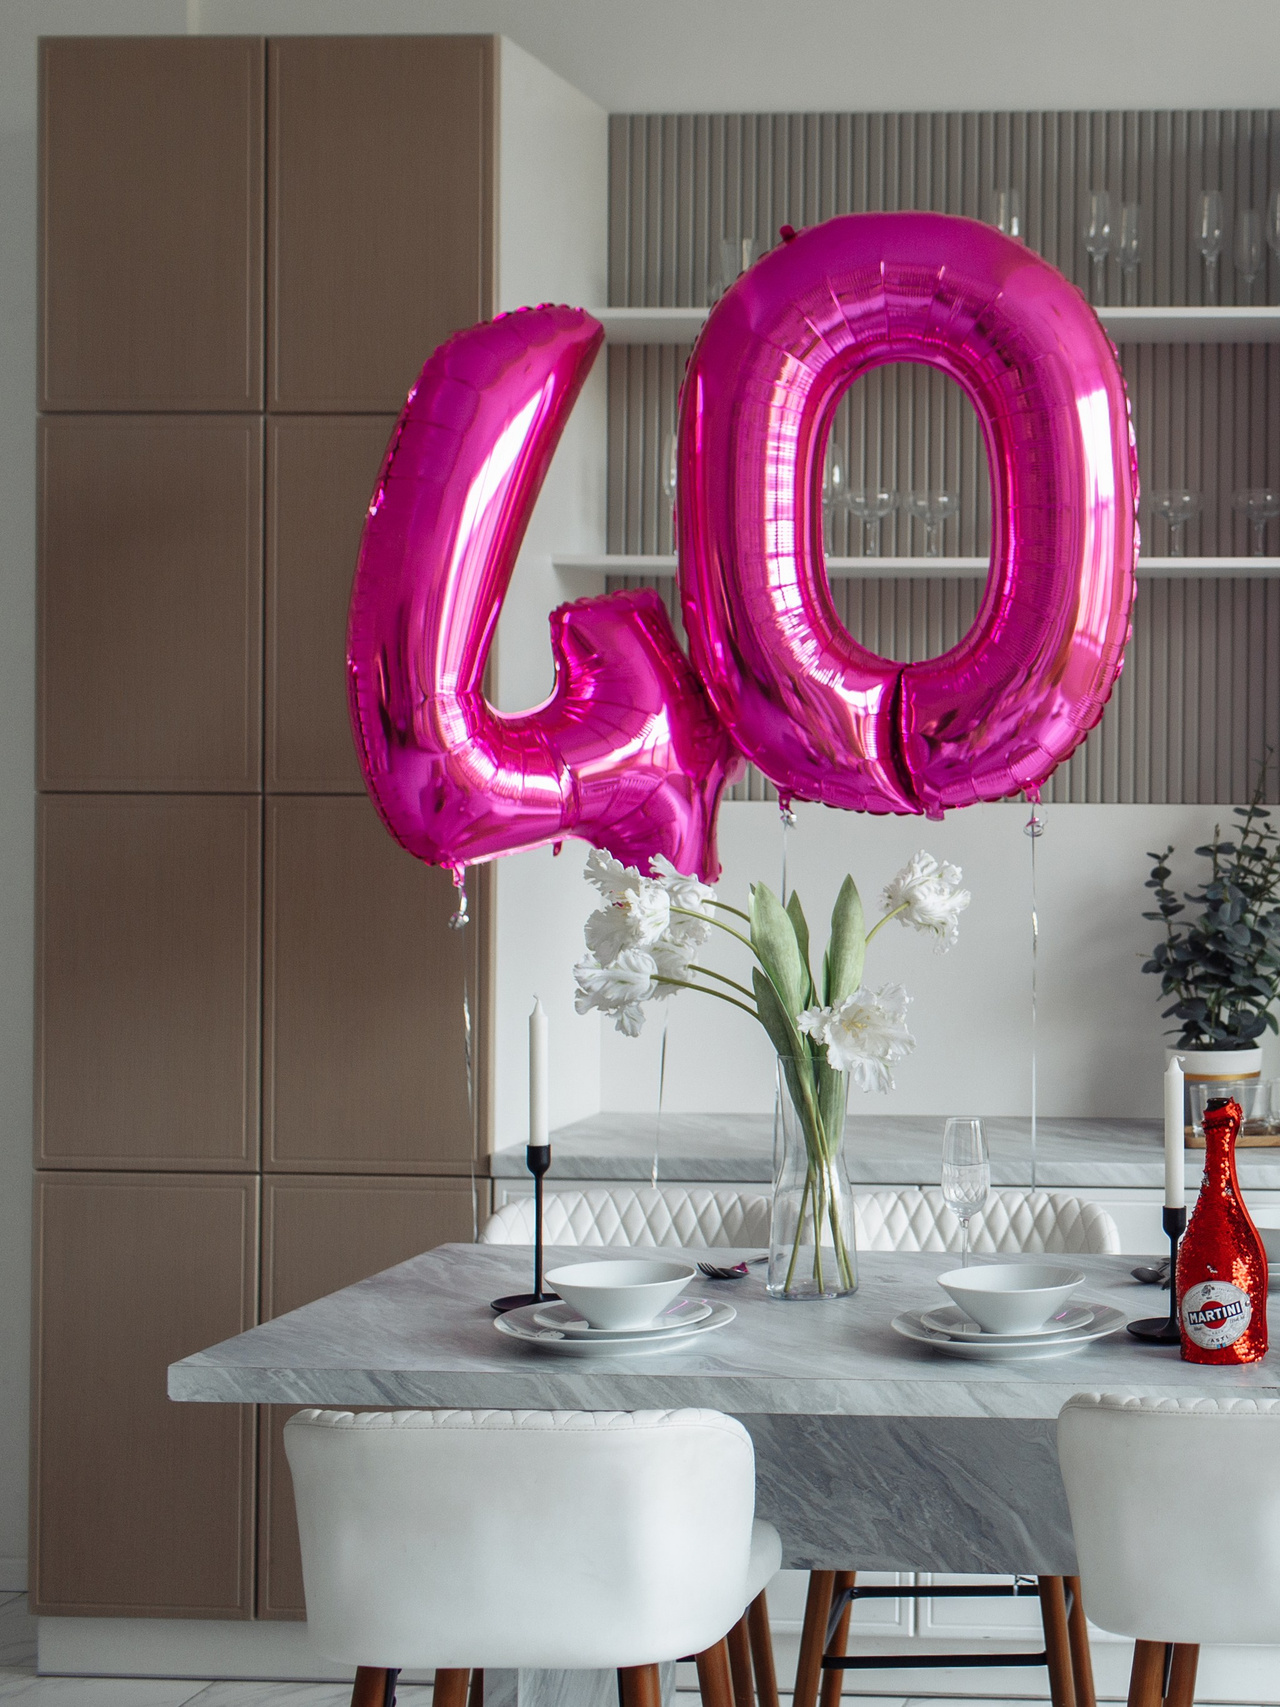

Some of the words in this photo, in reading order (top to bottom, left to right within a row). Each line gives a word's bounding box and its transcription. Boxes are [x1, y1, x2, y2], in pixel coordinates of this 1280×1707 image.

[346, 211, 1140, 885] 40
[1189, 1302, 1241, 1324] MARTINI
[1210, 1335, 1229, 1343] ASTI
